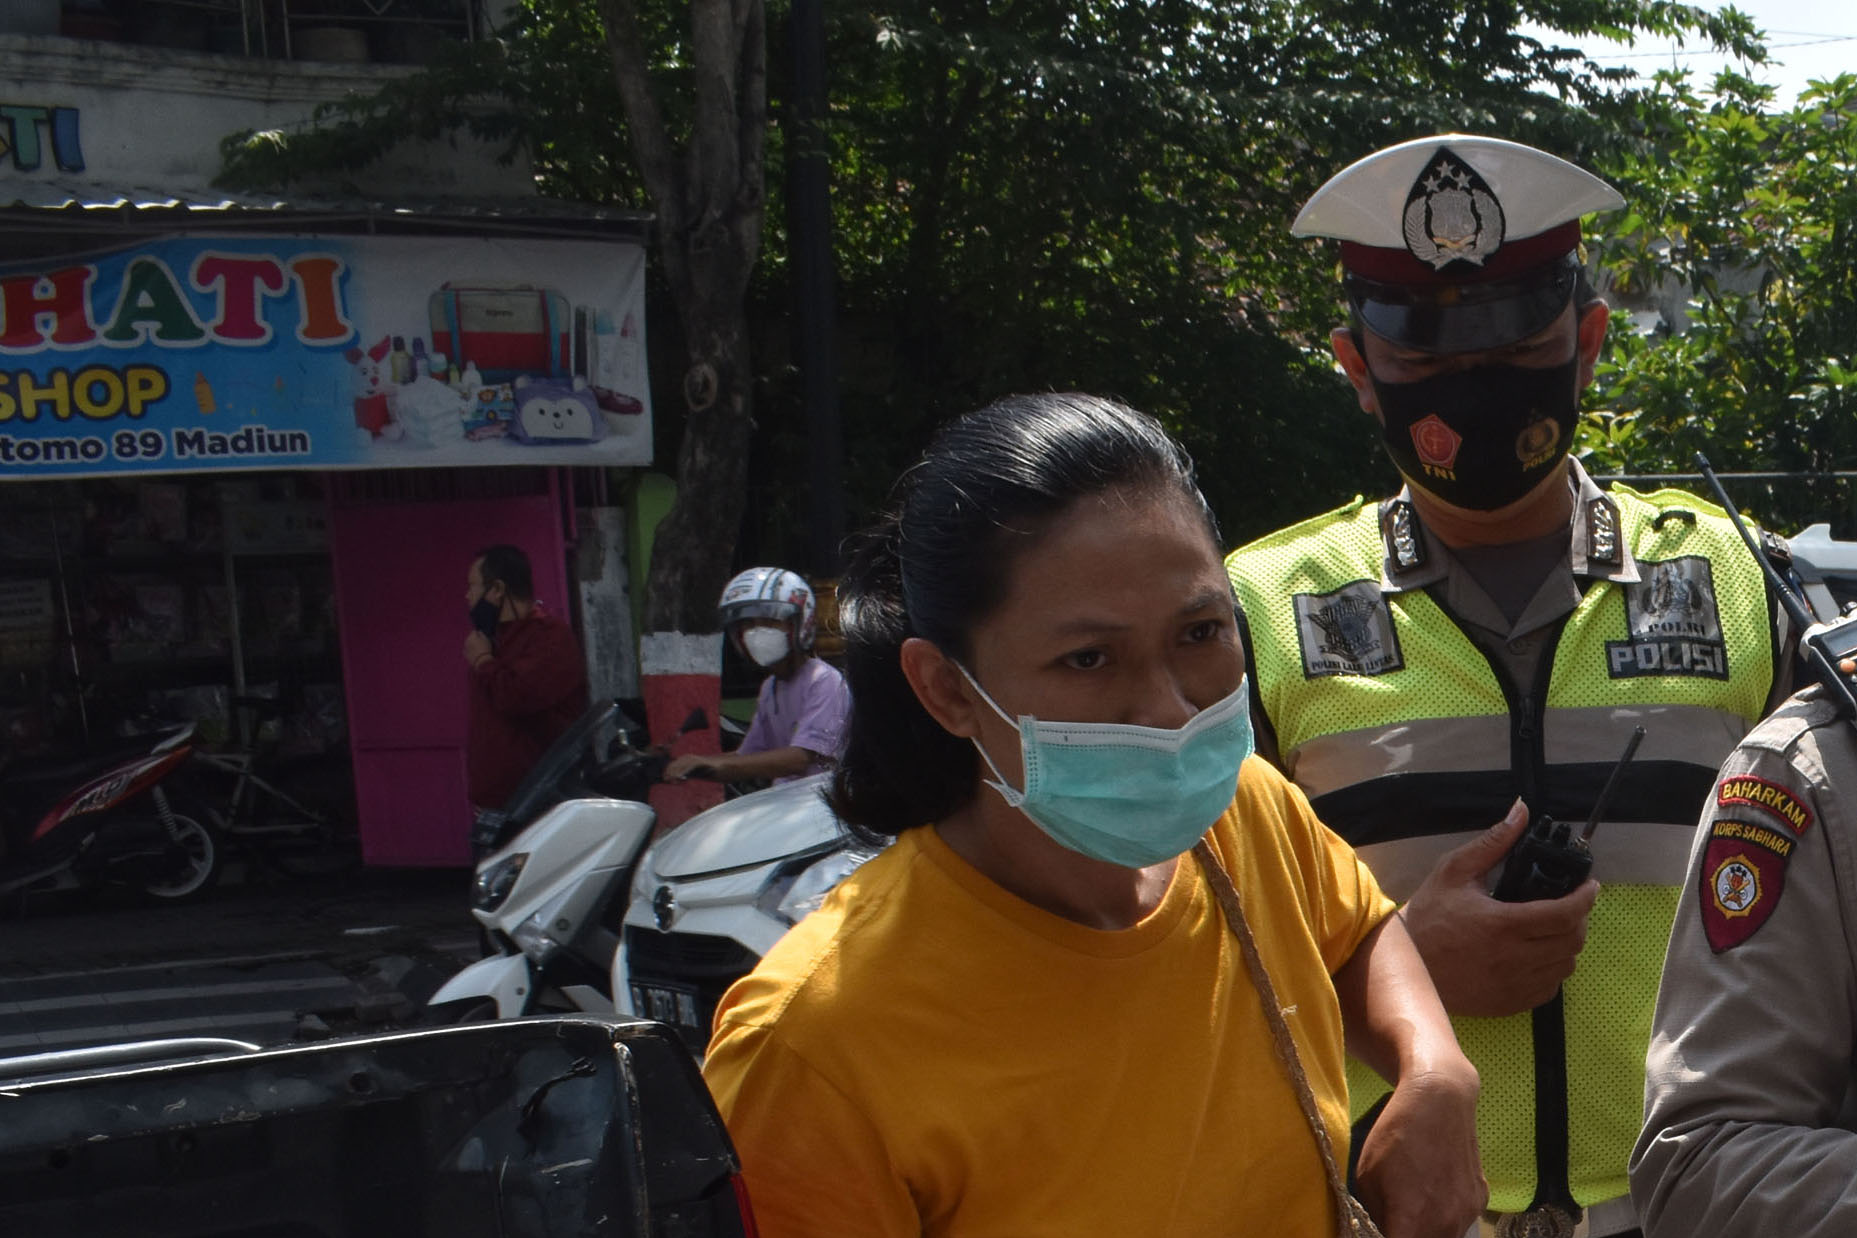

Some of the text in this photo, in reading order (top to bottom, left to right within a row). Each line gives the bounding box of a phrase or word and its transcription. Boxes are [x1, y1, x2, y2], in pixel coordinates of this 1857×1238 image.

[0, 105, 86, 172] TI
[114, 430, 163, 458] 89
[175, 426, 309, 457] Madiun
[1422, 463, 1457, 481] TNI
[1609, 643, 1724, 674] POLISI
[1722, 781, 1807, 828] BAHARKAM
[1712, 821, 1791, 857] KORPS SABHARA
